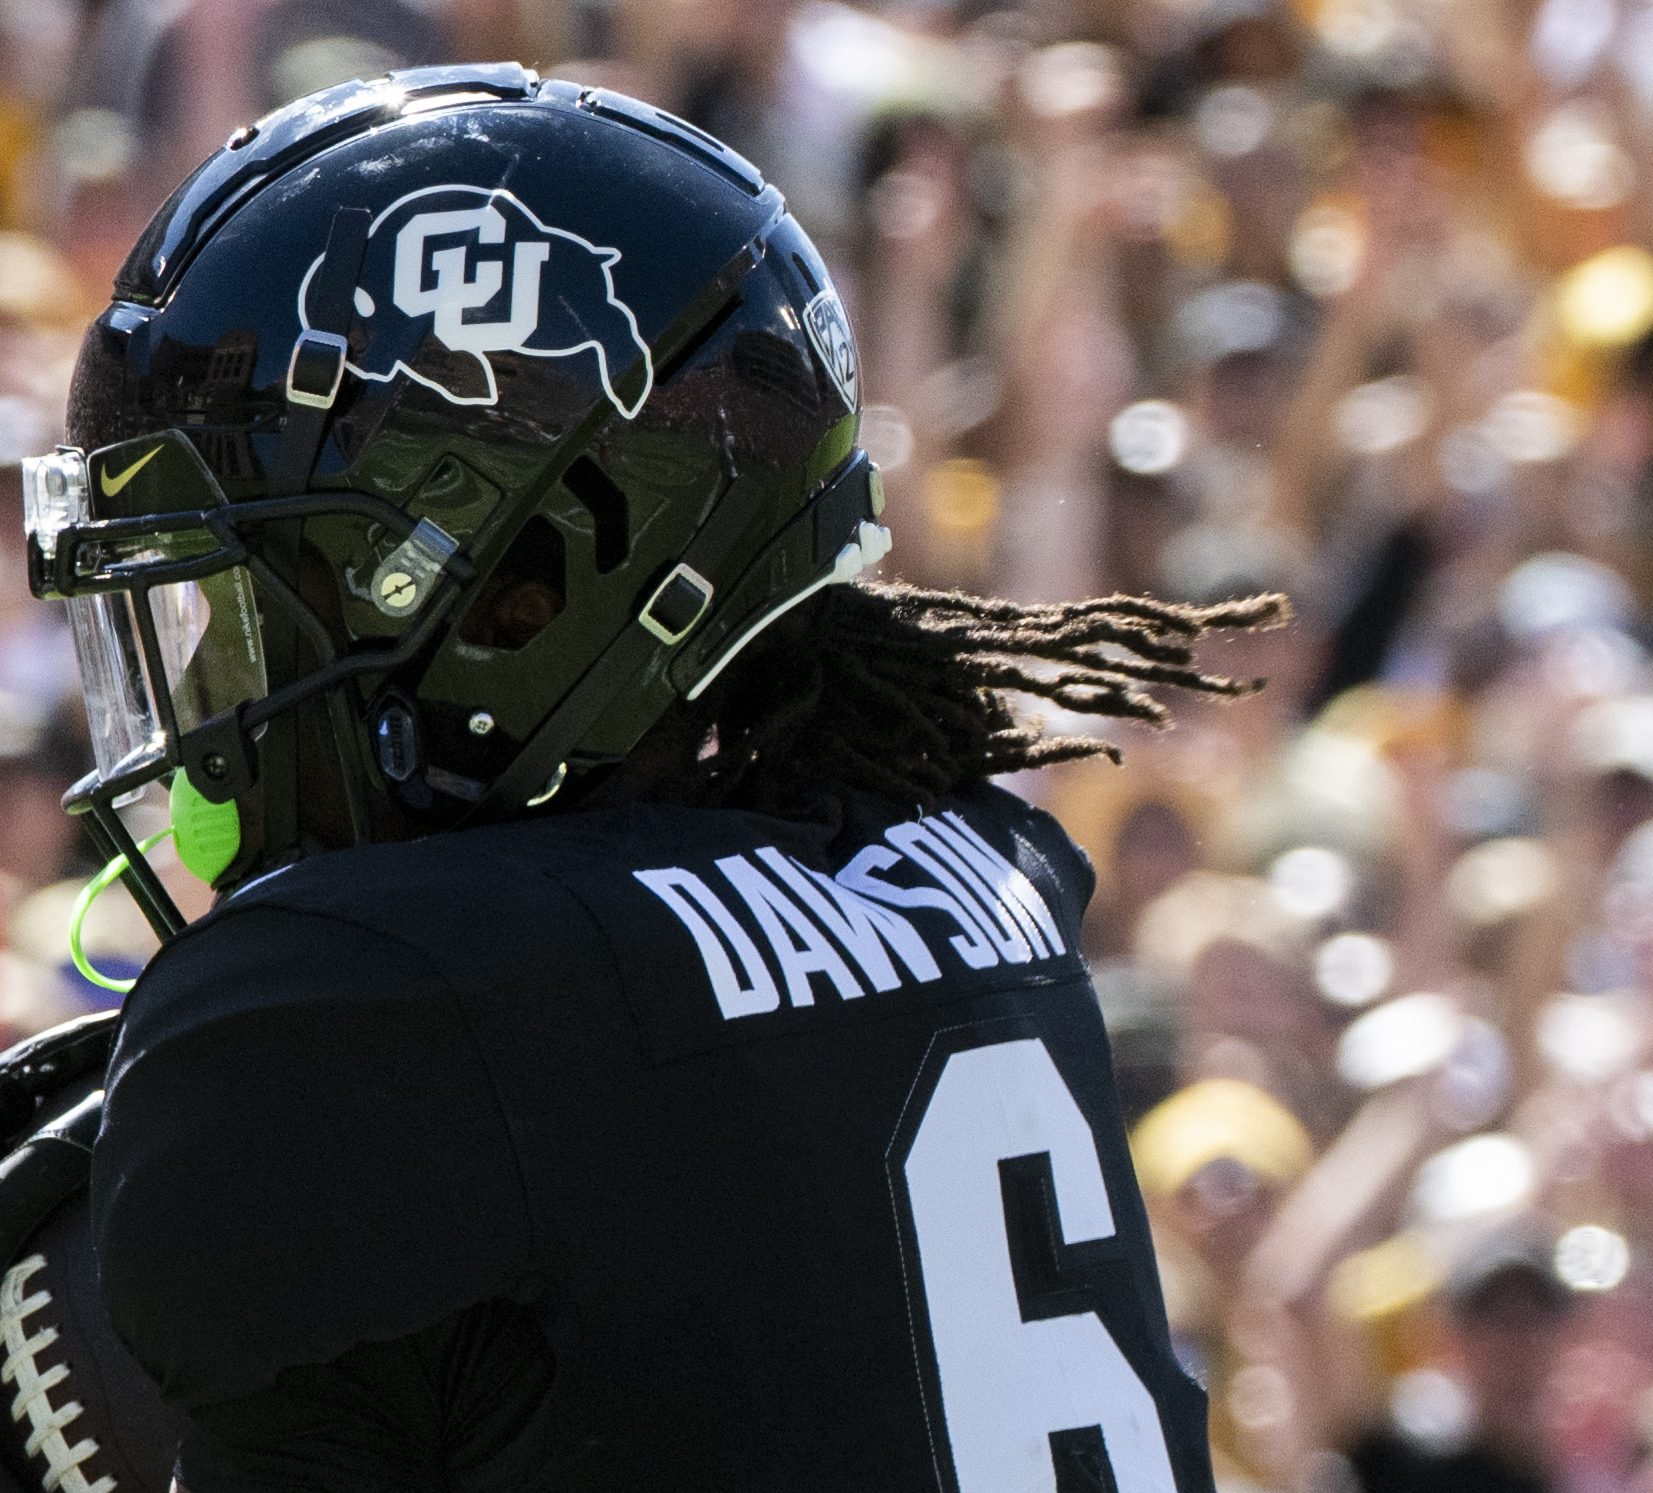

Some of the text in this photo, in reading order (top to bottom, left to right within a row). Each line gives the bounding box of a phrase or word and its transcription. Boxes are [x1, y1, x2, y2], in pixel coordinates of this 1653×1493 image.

[393, 205, 550, 352] CU
[232, 566, 257, 663] www.nikefootball.co
[632, 811, 1066, 1021] DAWSON
